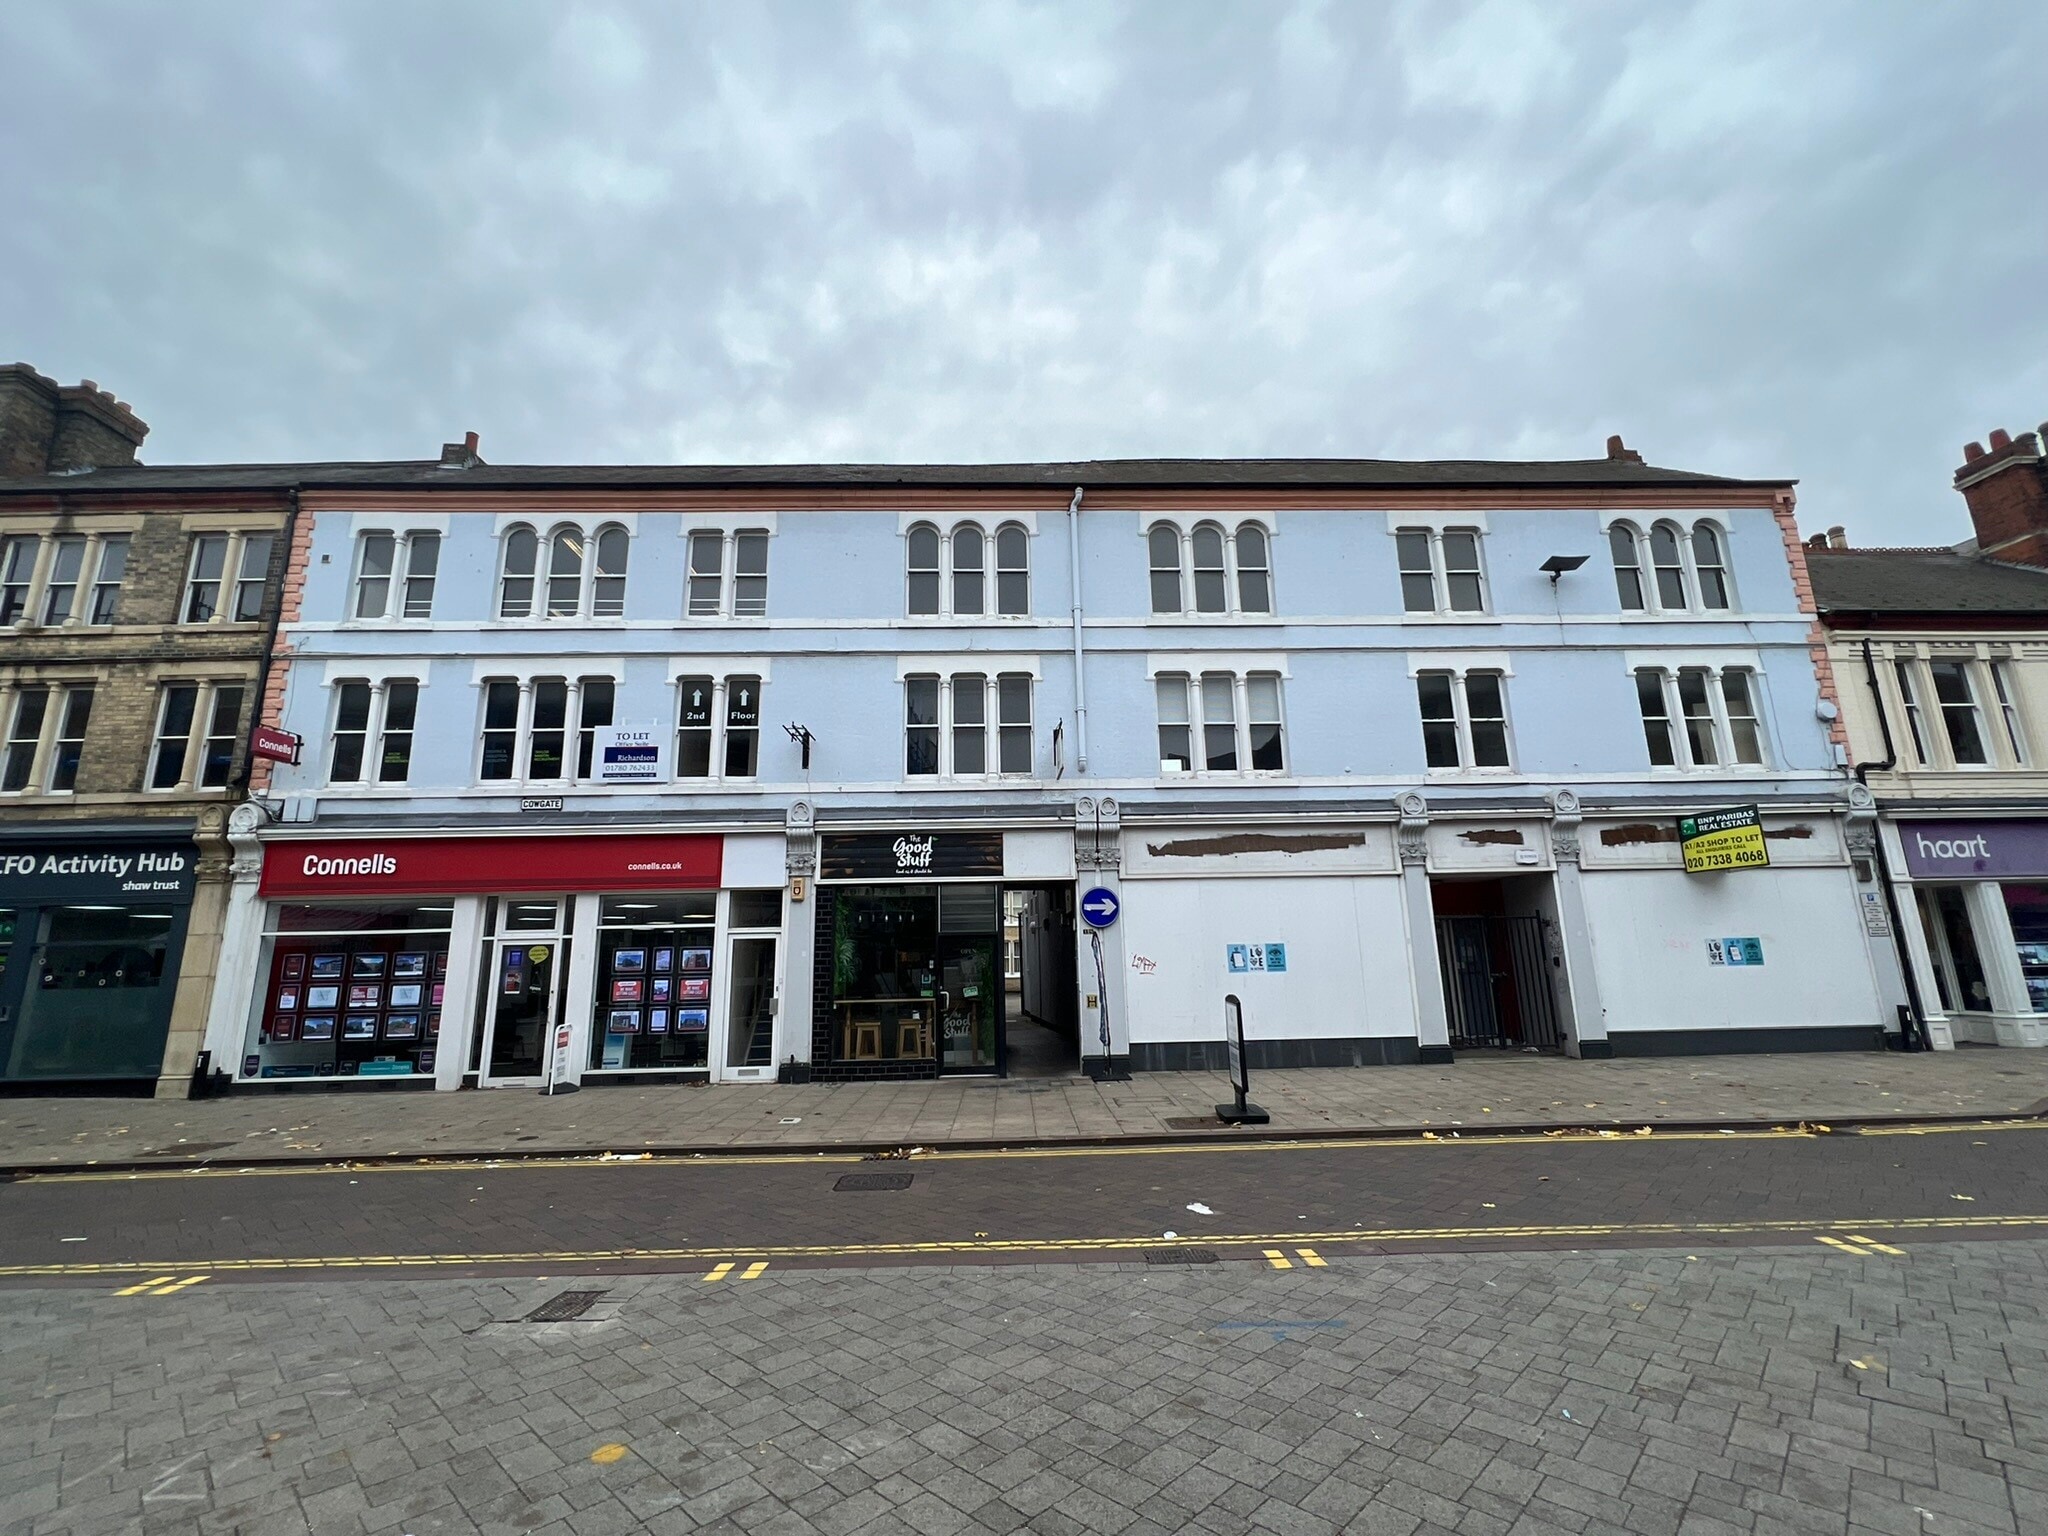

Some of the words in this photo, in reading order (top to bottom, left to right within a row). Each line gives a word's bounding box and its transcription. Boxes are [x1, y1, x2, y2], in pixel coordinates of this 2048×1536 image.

[687, 711, 706, 720] 2nd
[731, 711, 756, 720] Floor
[616, 732, 631, 740] TO
[633, 732, 650, 740] LET
[259, 738, 292, 755] Connells
[523, 800, 560, 808] COWGATE
[1697, 816, 1715, 825] BNP
[1716, 810, 1755, 821] PARIBAS
[1698, 822, 1719, 832] REAL
[1720, 818, 1753, 828] ESTATE
[893, 836, 933, 857] Good
[1685, 841, 1705, 850] A1/A2
[1707, 838, 1729, 847] SHOP
[1745, 834, 1759, 842] LET
[1916, 832, 1991, 858] haart
[40, 854, 132, 878] Activity
[137, 852, 185, 872] Hub
[303, 853, 397, 876] Connells
[628, 861, 682, 871] connells.co.uk
[897, 851, 932, 867] Stuff
[1687, 857, 1704, 868] 020
[1706, 853, 1732, 866] 7338
[1735, 850, 1764, 862] 4068
[122, 880, 151, 891] shaw
[153, 880, 180, 890] trust
[944, 1026, 970, 1039] Stuff
